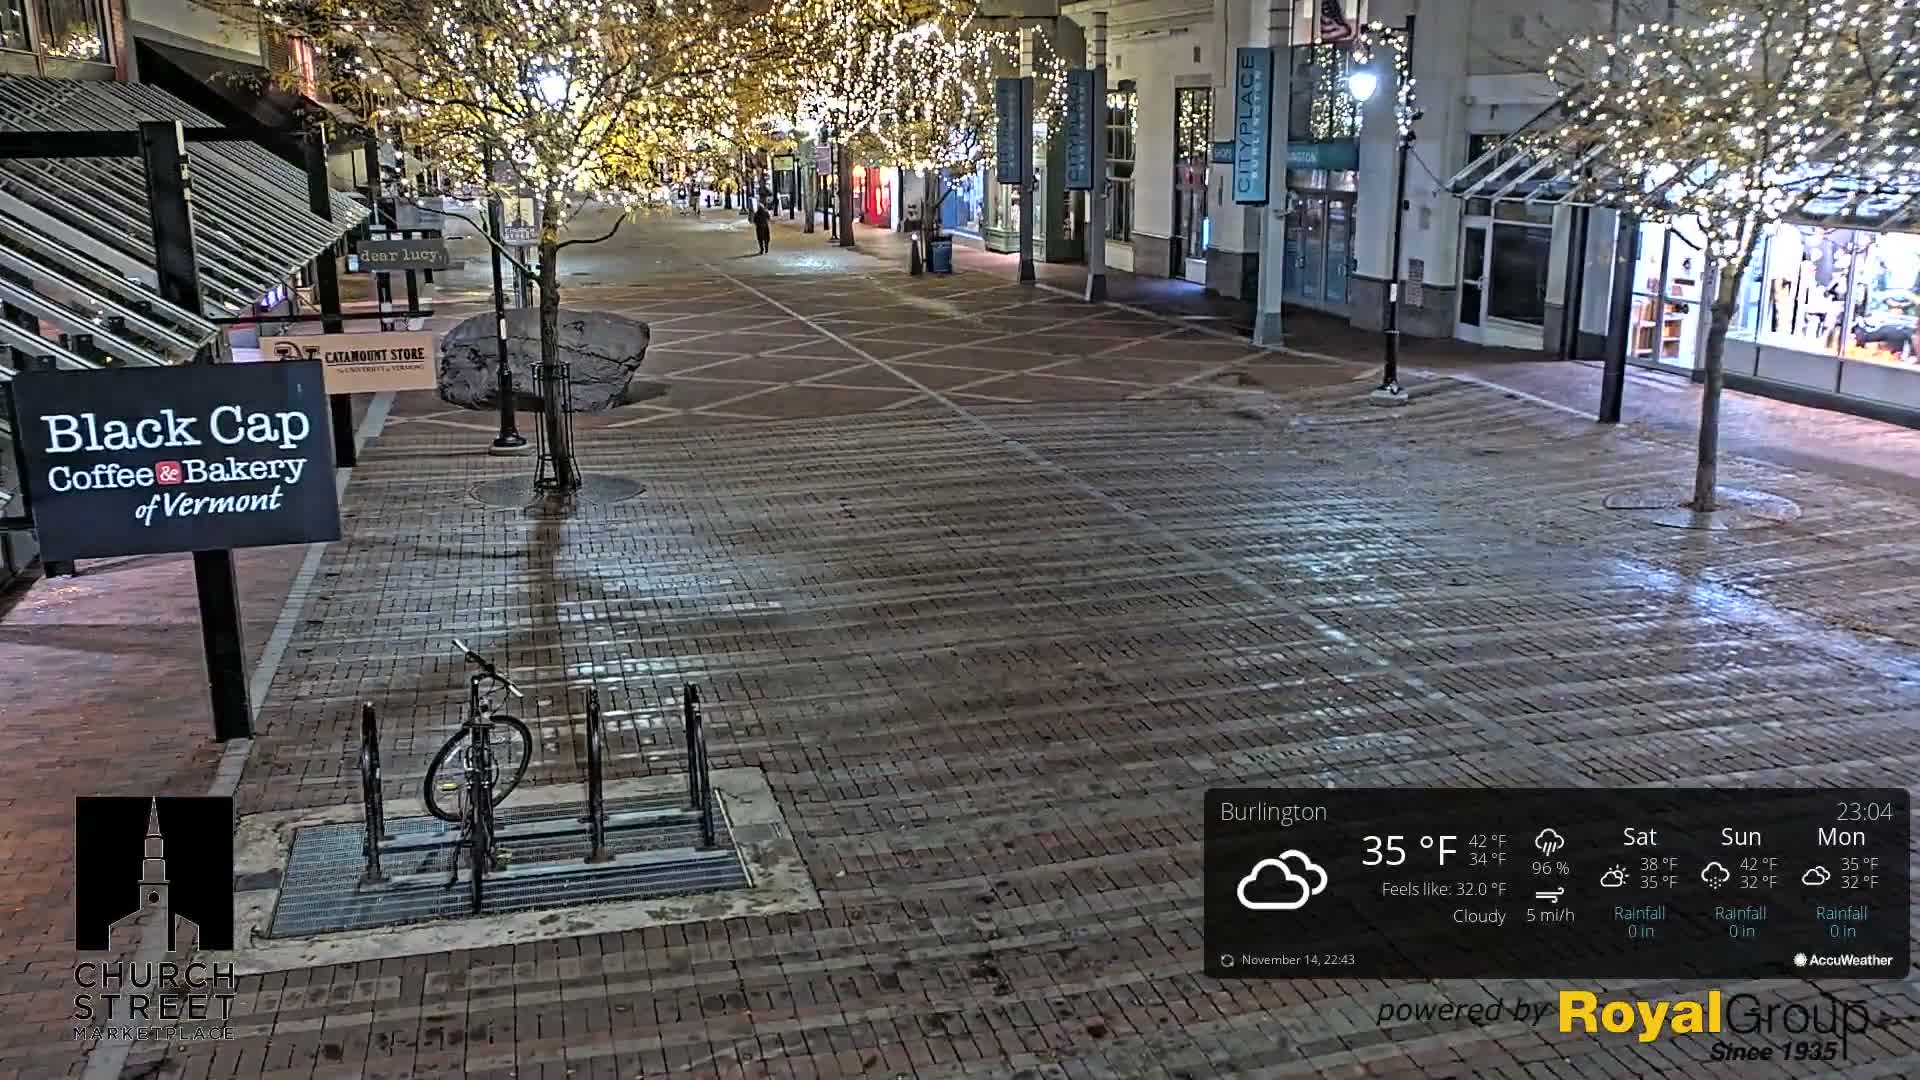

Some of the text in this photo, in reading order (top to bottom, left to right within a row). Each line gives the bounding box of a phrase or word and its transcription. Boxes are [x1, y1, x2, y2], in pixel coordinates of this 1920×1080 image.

[1238, 55, 1255, 193] CITYPLACE
[360, 249, 398, 263] dear
[325, 350, 387, 363] CATAMOUNT
[391, 348, 425, 360] STORE
[40, 405, 310, 453] Black Cap
[48, 464, 154, 492] Coffee
[181, 457, 308, 484] Bakery
[135, 486, 284, 526] of Vermont
